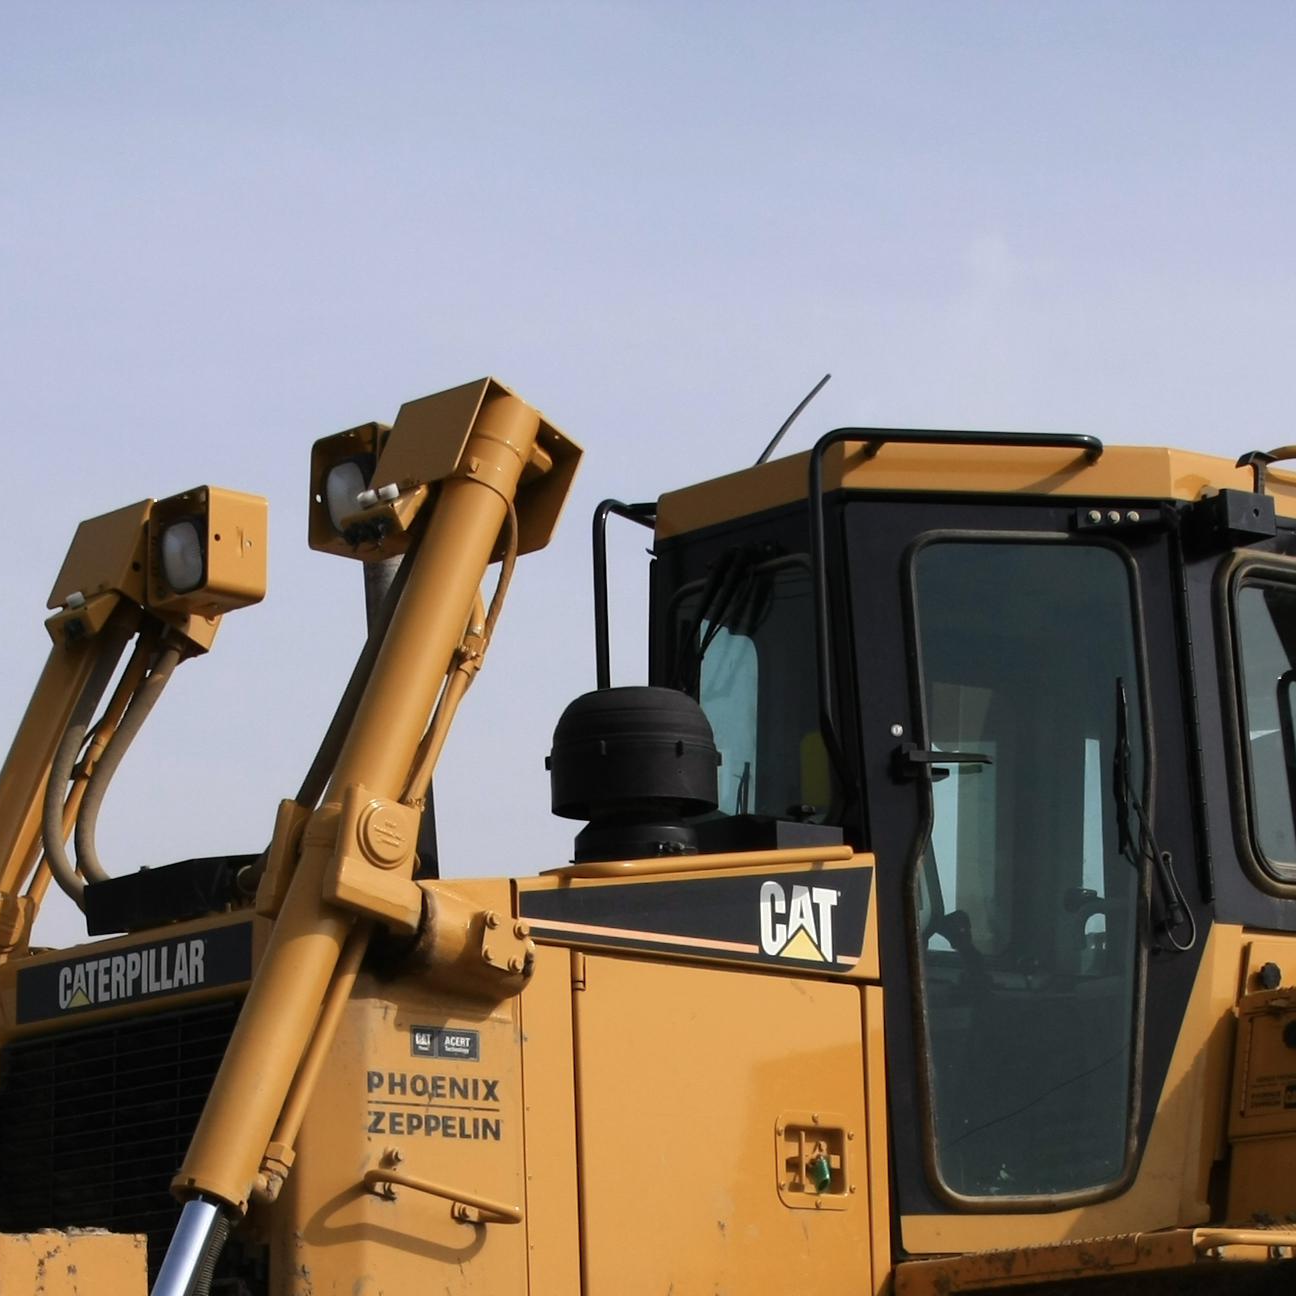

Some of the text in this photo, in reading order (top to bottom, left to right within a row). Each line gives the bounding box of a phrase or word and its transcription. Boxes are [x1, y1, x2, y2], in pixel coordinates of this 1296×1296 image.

[760, 881, 838, 963] CAT
[59, 939, 205, 1010] CATERPILLAR
[444, 1036, 471, 1048] ACERT
[367, 1071, 500, 1102] PHOENIX
[367, 1111, 501, 1141] ZEPPELIN
